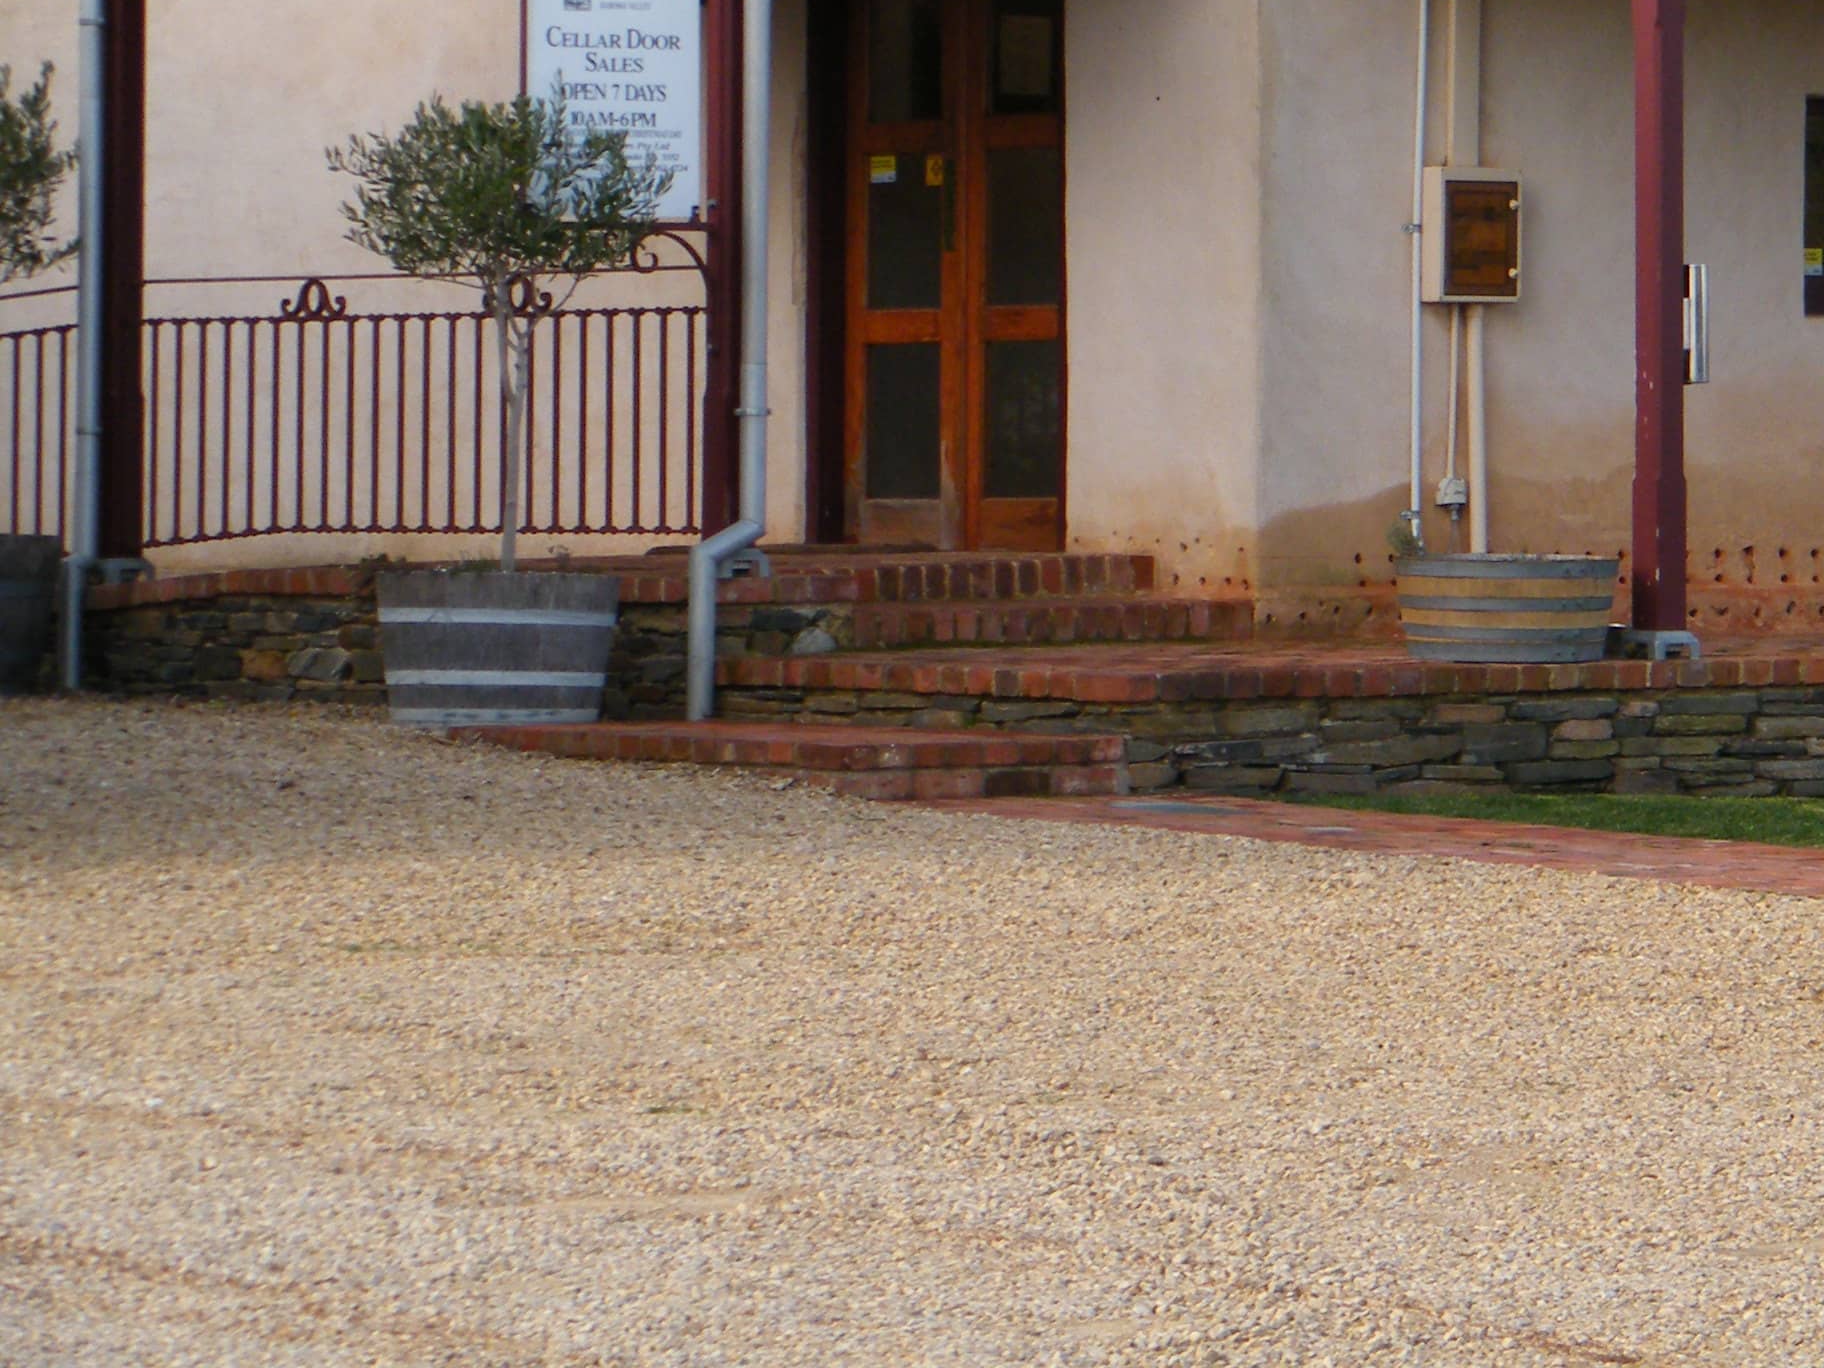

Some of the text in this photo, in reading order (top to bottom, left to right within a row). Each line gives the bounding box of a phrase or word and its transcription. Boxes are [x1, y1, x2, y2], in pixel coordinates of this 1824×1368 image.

[546, 25, 681, 50] CELLAR DOOR
[585, 51, 645, 73] SALES
[561, 82, 667, 102] OPEN 7 DAYS
